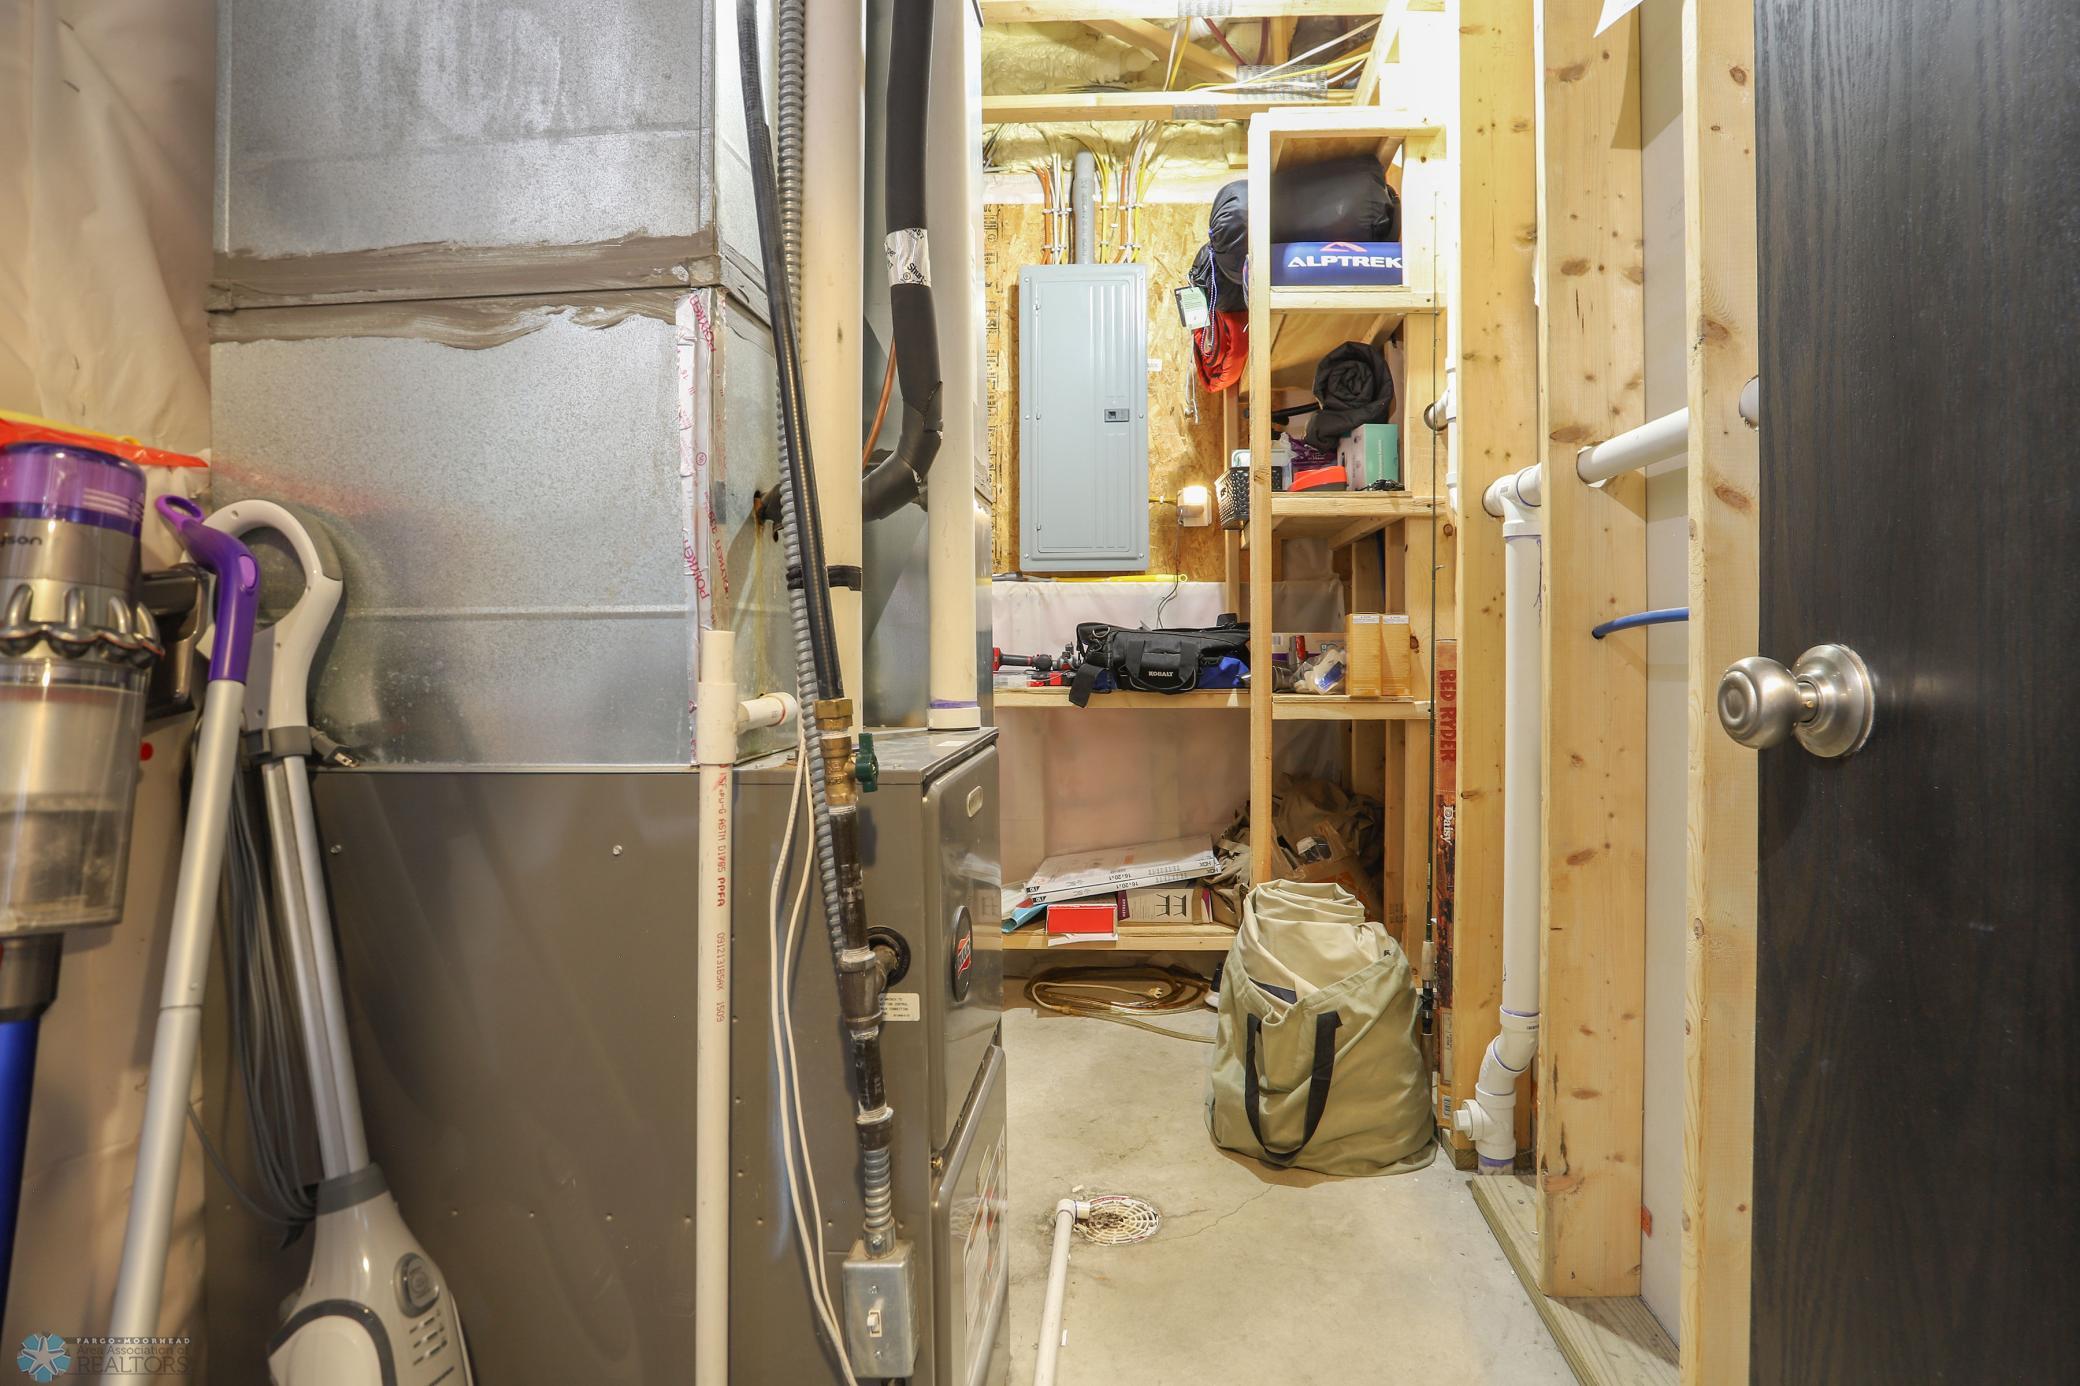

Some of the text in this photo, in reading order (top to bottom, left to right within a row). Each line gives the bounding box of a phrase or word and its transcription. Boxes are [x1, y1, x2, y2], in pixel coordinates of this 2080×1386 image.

[1288, 255, 1403, 269] ALPTREK
[1439, 670, 1457, 763] RED RYDER
[1440, 805, 1454, 846] Daisy
